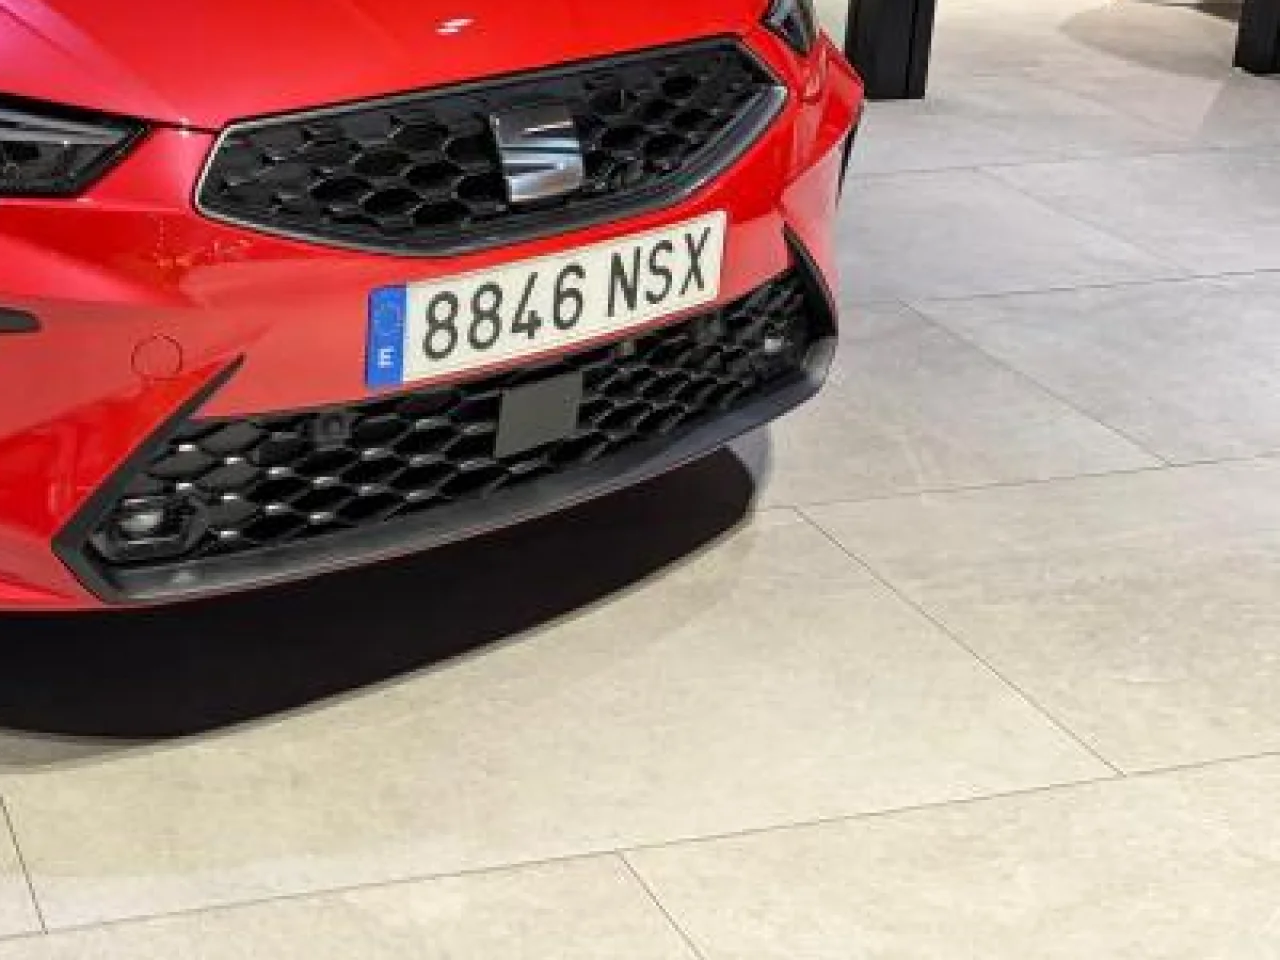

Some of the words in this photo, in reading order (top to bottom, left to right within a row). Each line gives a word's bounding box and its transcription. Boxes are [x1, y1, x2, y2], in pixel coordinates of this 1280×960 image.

[422, 265, 586, 360] 8846
[607, 226, 712, 318] NSX
[377, 345, 395, 369] E
